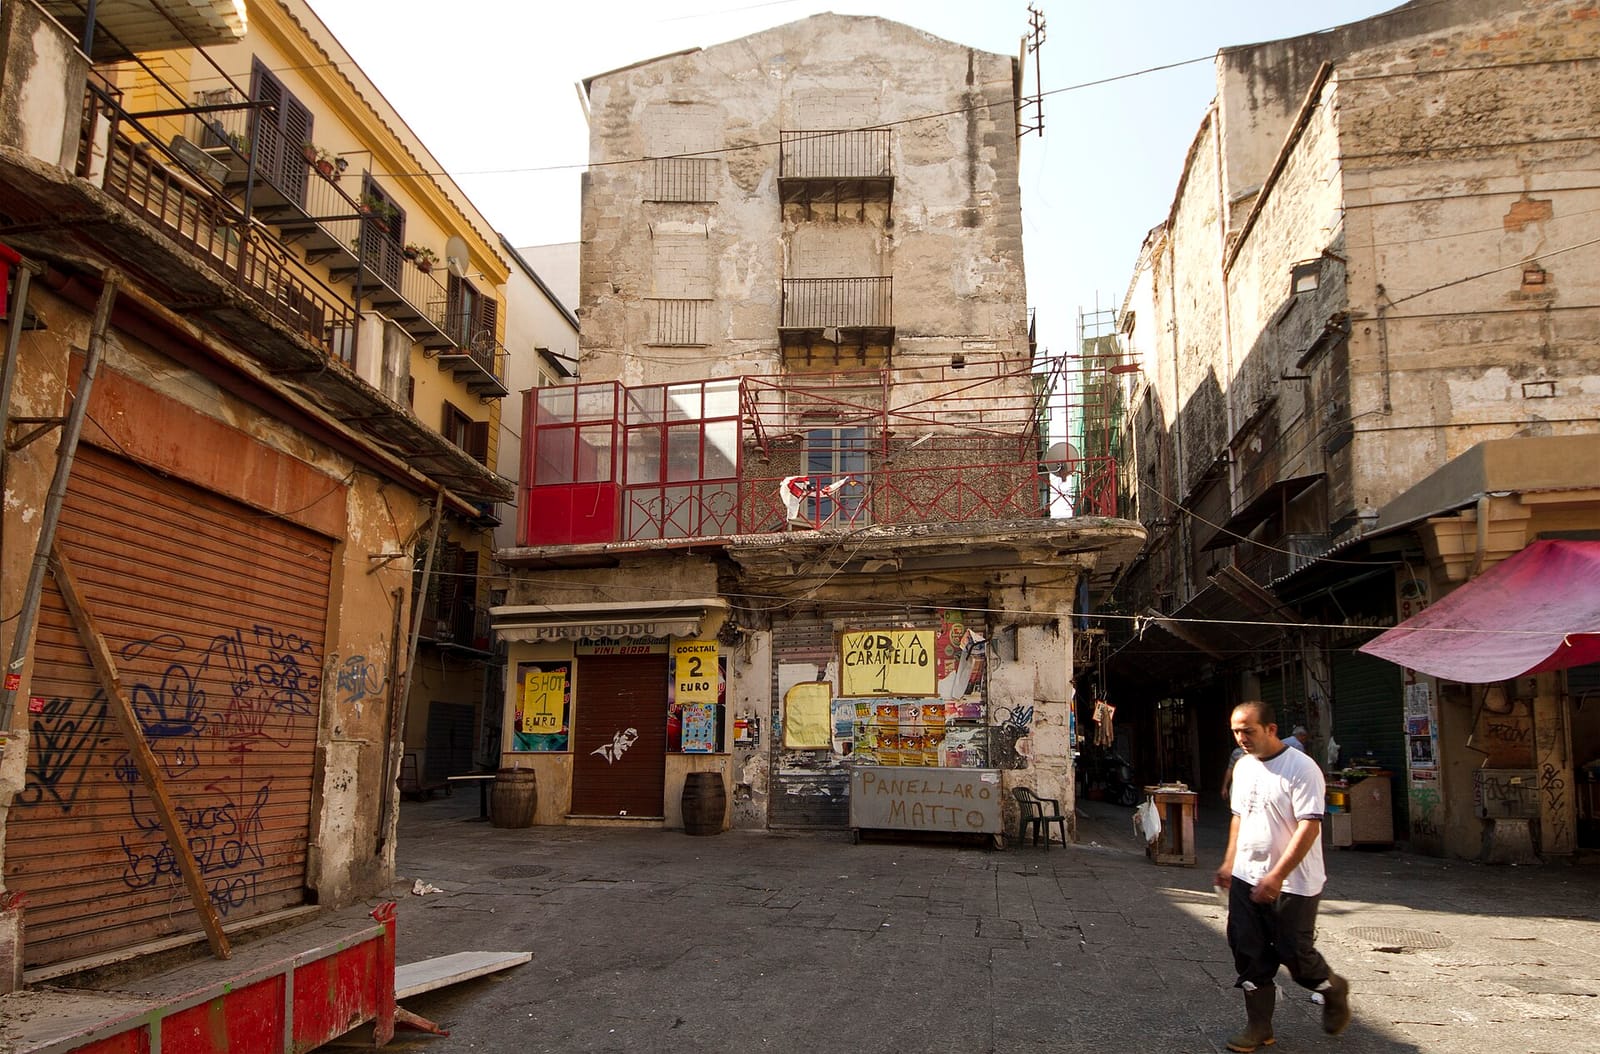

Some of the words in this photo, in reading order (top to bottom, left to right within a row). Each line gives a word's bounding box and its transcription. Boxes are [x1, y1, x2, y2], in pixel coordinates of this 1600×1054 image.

[677, 645, 716, 653] COCKTAIL
[847, 633, 923, 650] WODKA
[593, 647, 614, 655] VINI
[620, 646, 651, 655] BIRRA
[845, 649, 928, 667] CARAMELLO
[688, 656, 703, 677] 2
[530, 675, 565, 692] SHOT
[680, 682, 709, 692] EURO
[873, 665, 889, 692] 1
[535, 692, 552, 716] 1
[525, 717, 556, 727] EURO
[863, 772, 990, 799] PANELLARO
[887, 799, 985, 828] MATTO
